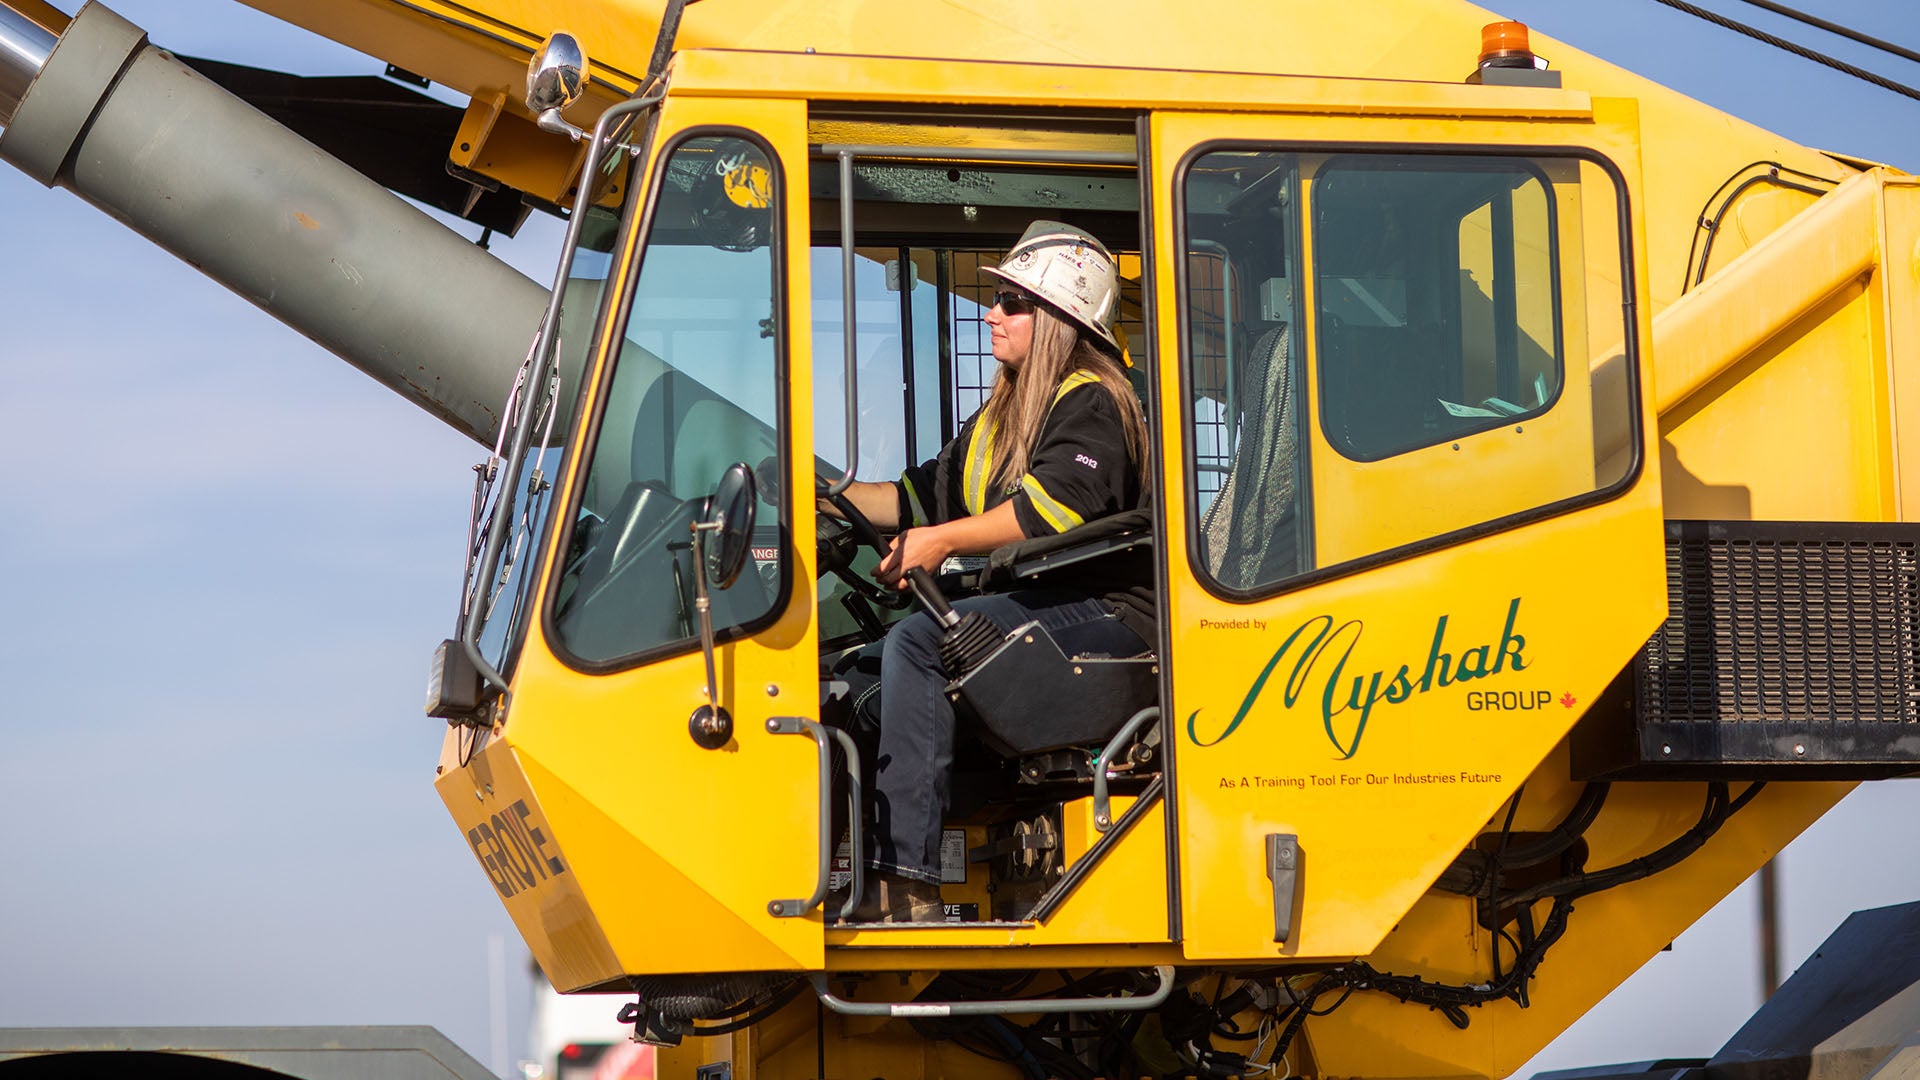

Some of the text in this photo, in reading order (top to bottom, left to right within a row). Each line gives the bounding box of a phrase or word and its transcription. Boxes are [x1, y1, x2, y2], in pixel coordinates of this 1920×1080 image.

[1075, 453, 1097, 469] 2013
[1200, 619, 1267, 631] Provided by
[1187, 597, 1534, 761] Myshak
[1467, 691, 1552, 712] GROUP
[1219, 772, 1502, 790] As A Training Tool For Our Industries Future
[468, 799, 565, 898] GROVE
